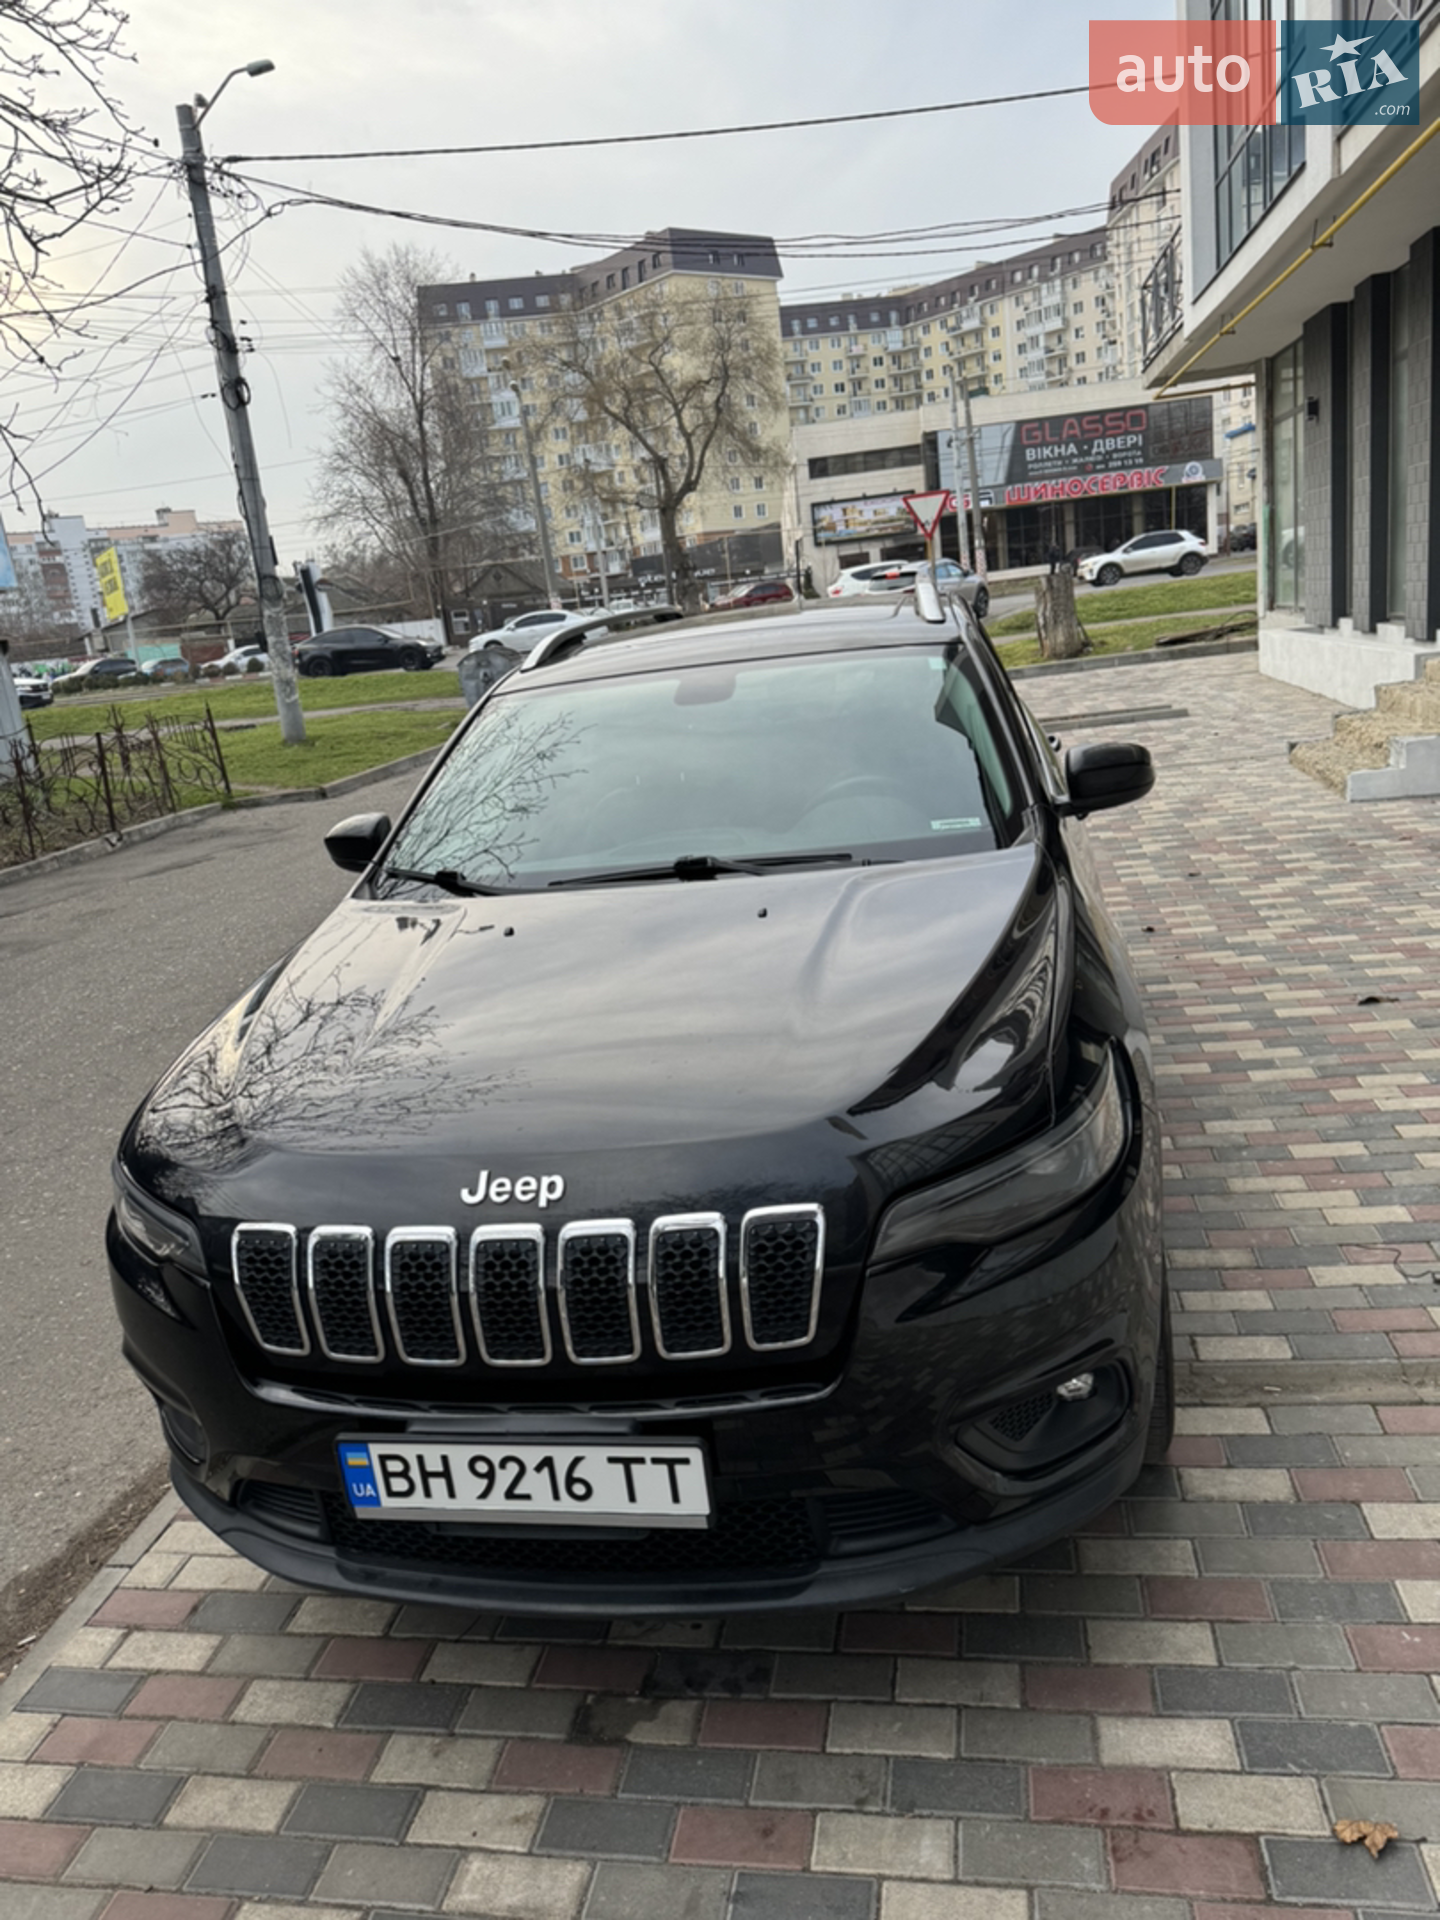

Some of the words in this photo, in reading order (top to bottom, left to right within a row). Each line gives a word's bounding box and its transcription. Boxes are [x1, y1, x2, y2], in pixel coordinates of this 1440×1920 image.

[1021, 409, 1147, 445] GLASSO
[1025, 442, 1078, 461] ВІКНА
[1091, 434, 1143, 455] ДВЕРІ
[1005, 465, 1169, 505] ШИНОСЕРВІС
[460, 1169, 565, 1208] Jeep
[352, 1483, 377, 1498] UA
[377, 1453, 456, 1499] BH
[467, 1454, 594, 1501] 9216
[606, 1456, 691, 1504] TT
